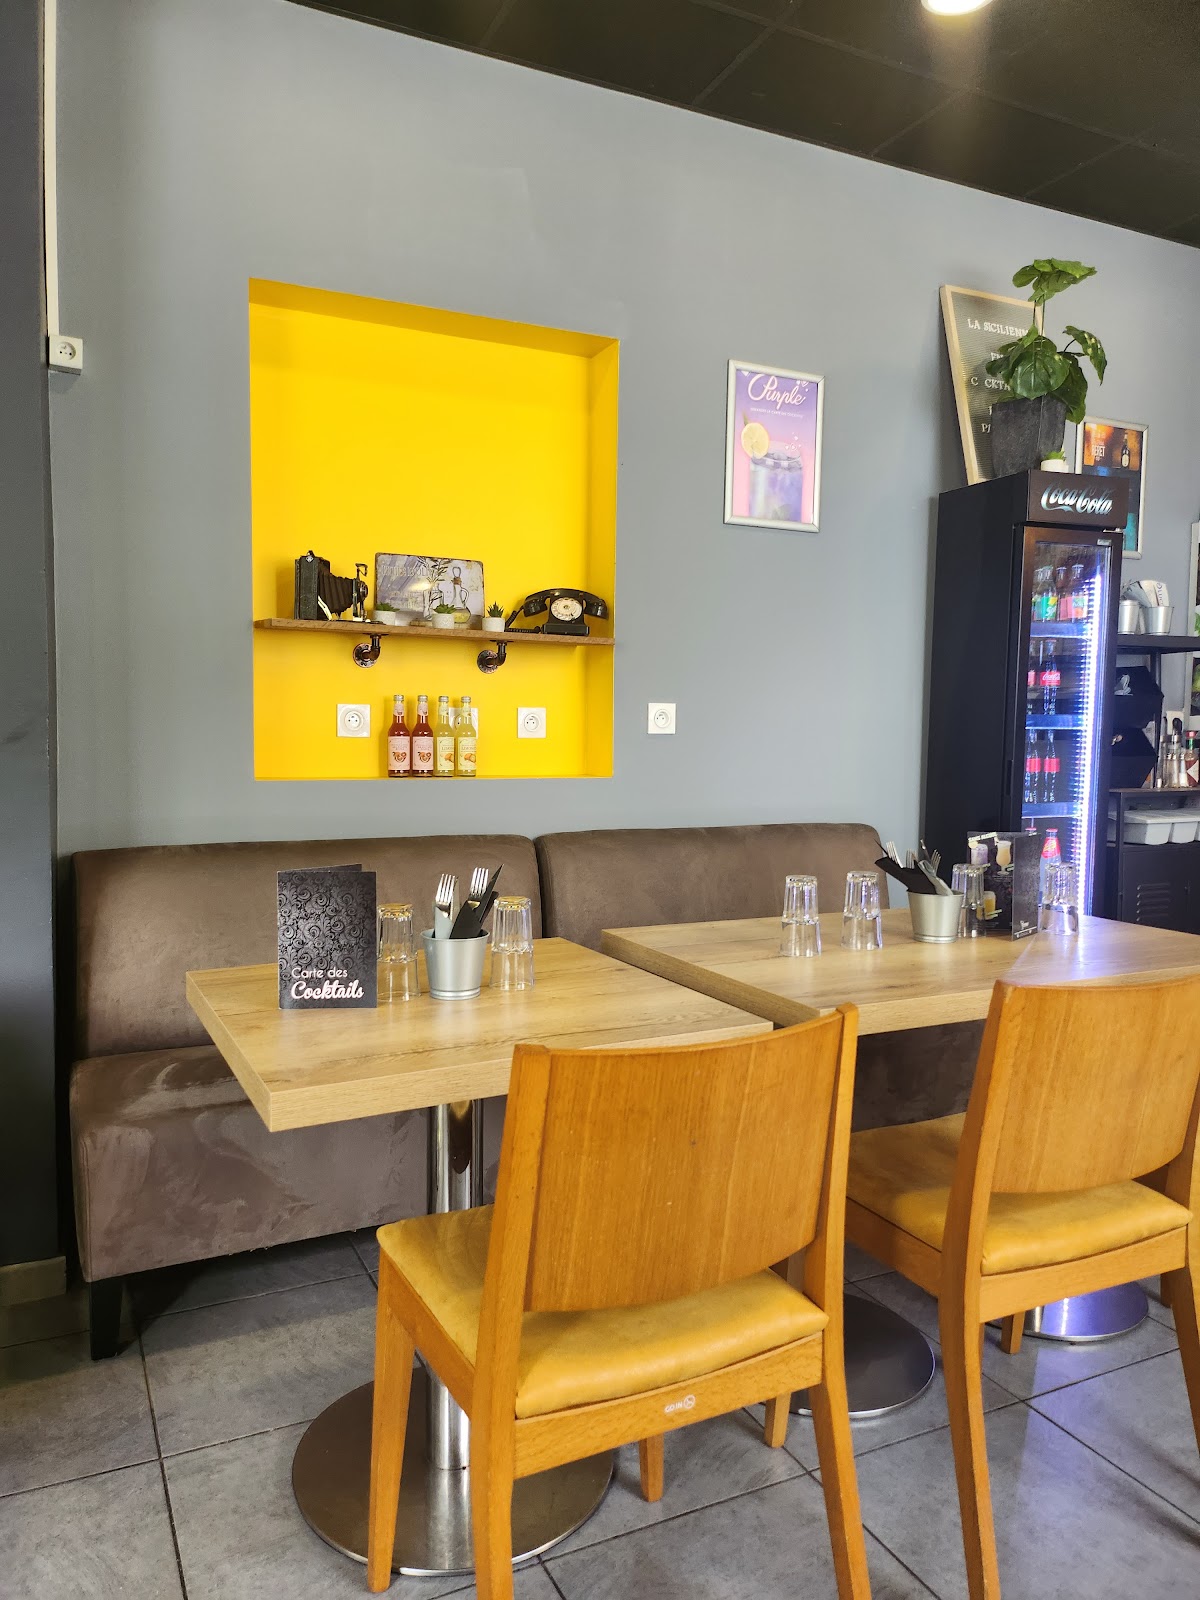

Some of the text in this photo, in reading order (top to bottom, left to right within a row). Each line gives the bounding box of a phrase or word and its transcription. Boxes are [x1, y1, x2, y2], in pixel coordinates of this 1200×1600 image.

[967, 318, 1029, 338] LA SICILIENN
[748, 374, 806, 410] Purple
[984, 378, 1011, 392] CKTA
[291, 966, 348, 978] Carte des
[290, 979, 364, 1000] Cocktails
